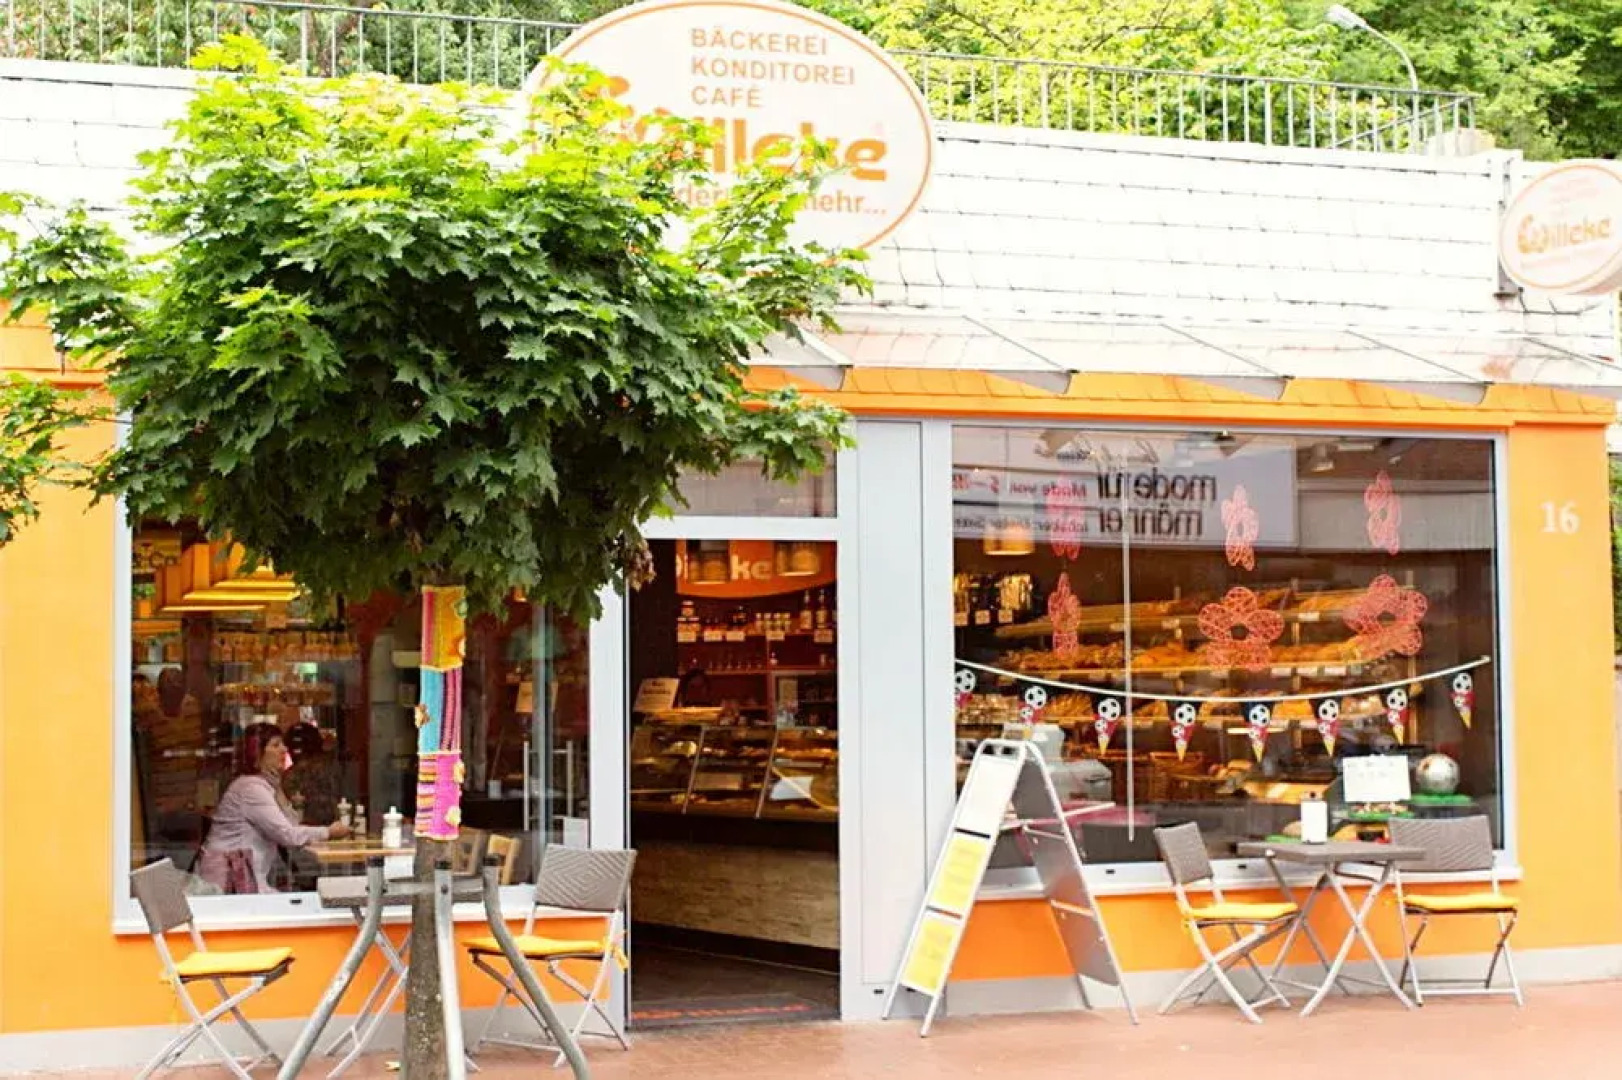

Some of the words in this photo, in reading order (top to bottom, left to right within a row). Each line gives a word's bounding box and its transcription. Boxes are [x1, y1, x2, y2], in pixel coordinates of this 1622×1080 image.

[690, 26, 828, 55] BÄCKEREI
[690, 55, 856, 85] KONDITOREI
[690, 82, 764, 108] CAFÉ
[1538, 500, 1581, 535] 16
